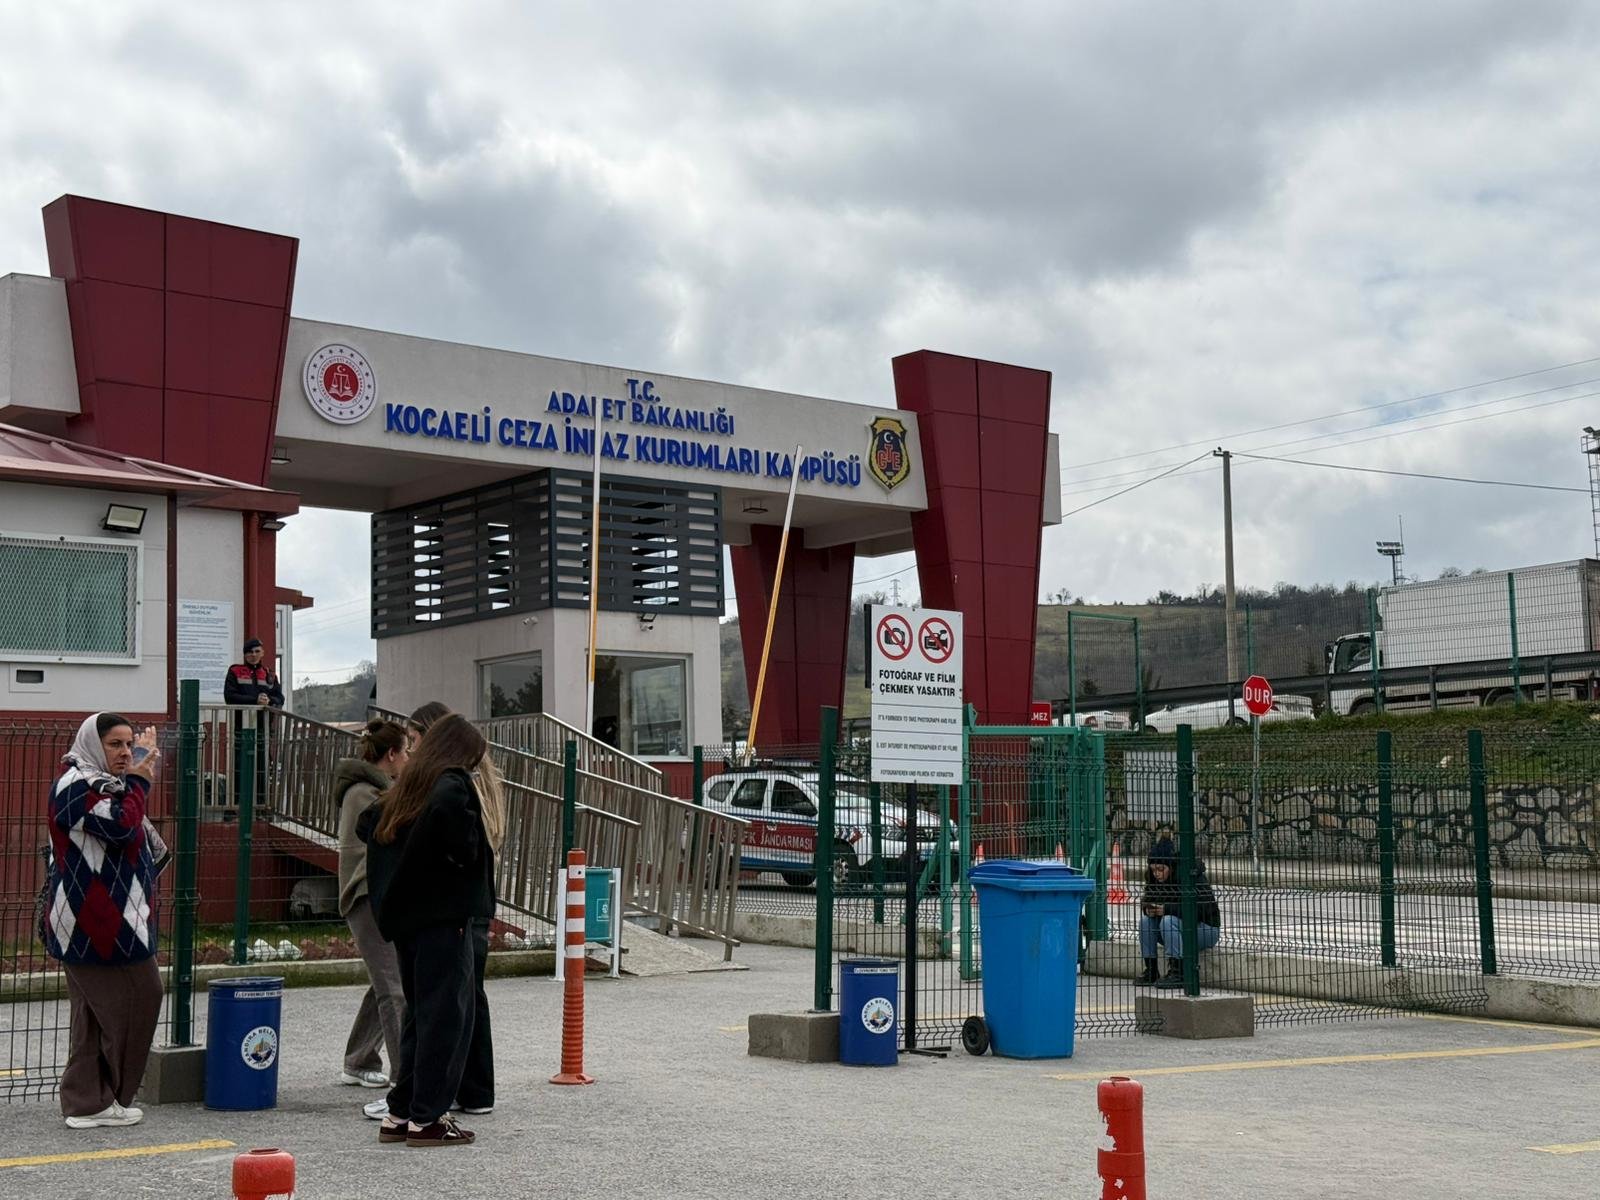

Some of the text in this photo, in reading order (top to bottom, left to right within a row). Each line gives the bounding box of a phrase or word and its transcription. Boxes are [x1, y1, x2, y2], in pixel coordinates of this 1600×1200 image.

[626, 378, 661, 402] T.C.
[631, 401, 734, 435] BAKANLIĞI
[386, 402, 491, 443] KOCAELİ
[499, 417, 558, 450] CEZA
[635, 435, 759, 475] KURUMLARI
[766, 451, 861, 486] KAMPÜSÜ
[879, 669, 956, 683] FOTOĞRAF VE FİLM
[879, 683, 956, 697] ÇEKMEK YASAKTIR
[1245, 686, 1270, 705] DUR
[760, 824, 813, 850] JANDARMASI
